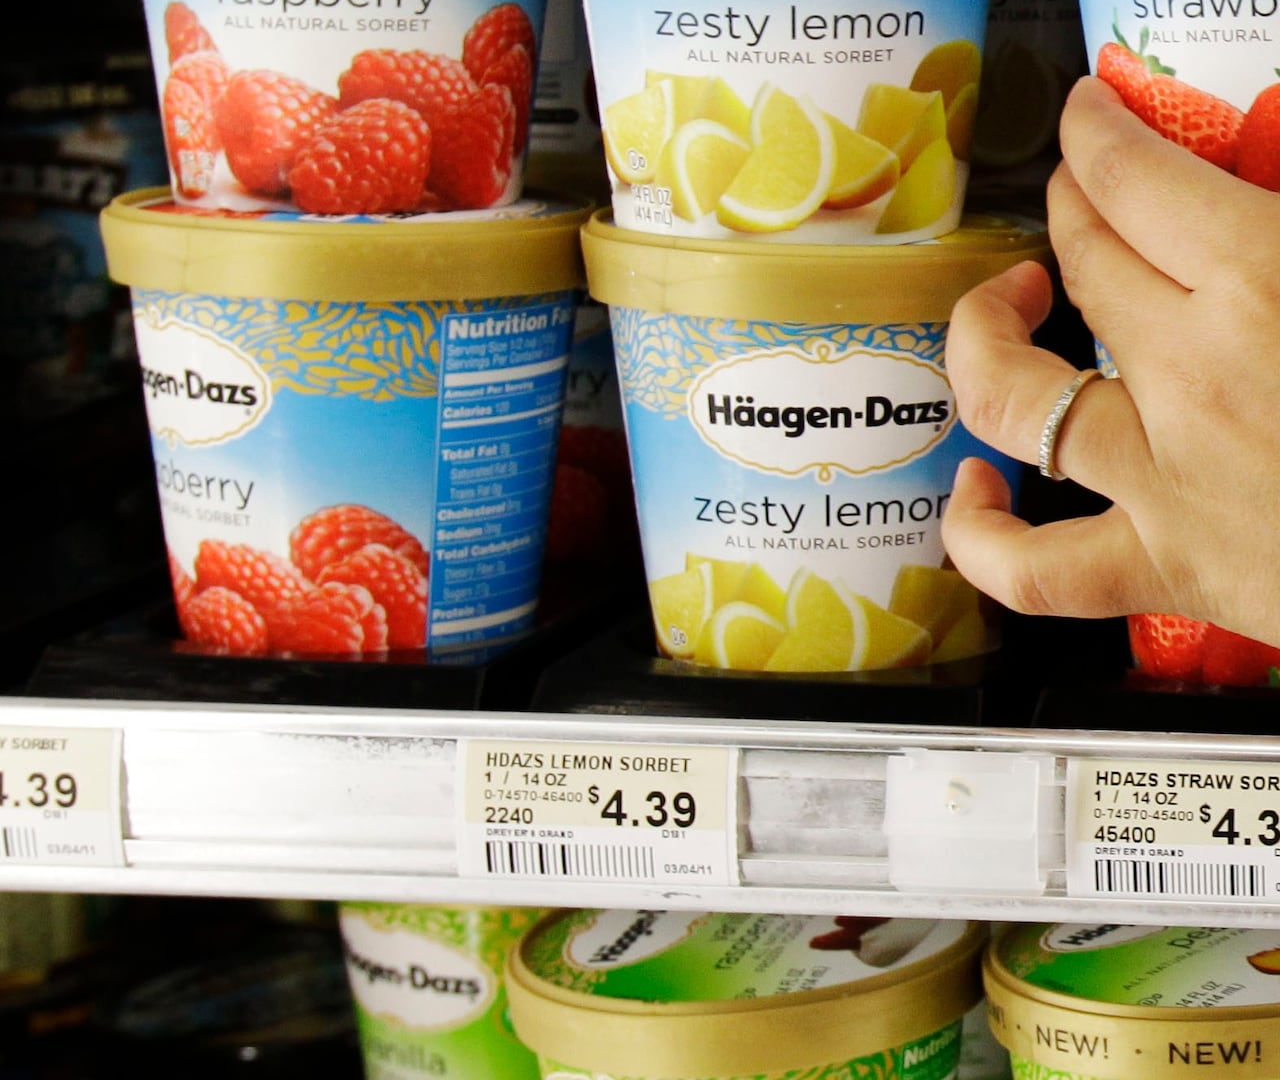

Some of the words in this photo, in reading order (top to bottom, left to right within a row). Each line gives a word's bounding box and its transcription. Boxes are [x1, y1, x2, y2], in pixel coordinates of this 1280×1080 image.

[654, 8, 770, 47] zesty
[790, 5, 925, 40] lemon
[1151, 29, 1181, 44] ALL
[1186, 28, 1273, 44] NATURAL
[687, 48, 720, 63] ALL
[727, 50, 817, 65] NATURAL
[824, 48, 894, 64] SORBET
[449, 312, 547, 339] Nutrition
[694, 496, 805, 533] zesty
[486, 753, 544, 768] HDAZS
[551, 754, 613, 770] LEMON
[620, 756, 691, 773] SORBET
[1096, 771, 1158, 786] HDAZS
[1167, 773, 1234, 789] STRAW
[588, 785, 696, 828] $4.39
[1133, 792, 1150, 805] 14
[1155, 792, 1178, 805] OZ
[484, 807, 533, 825] 2240
[1094, 826, 1156, 844] 45400
[1036, 1025, 1109, 1060] NEW!
[1168, 1041, 1262, 1065] NEW!
